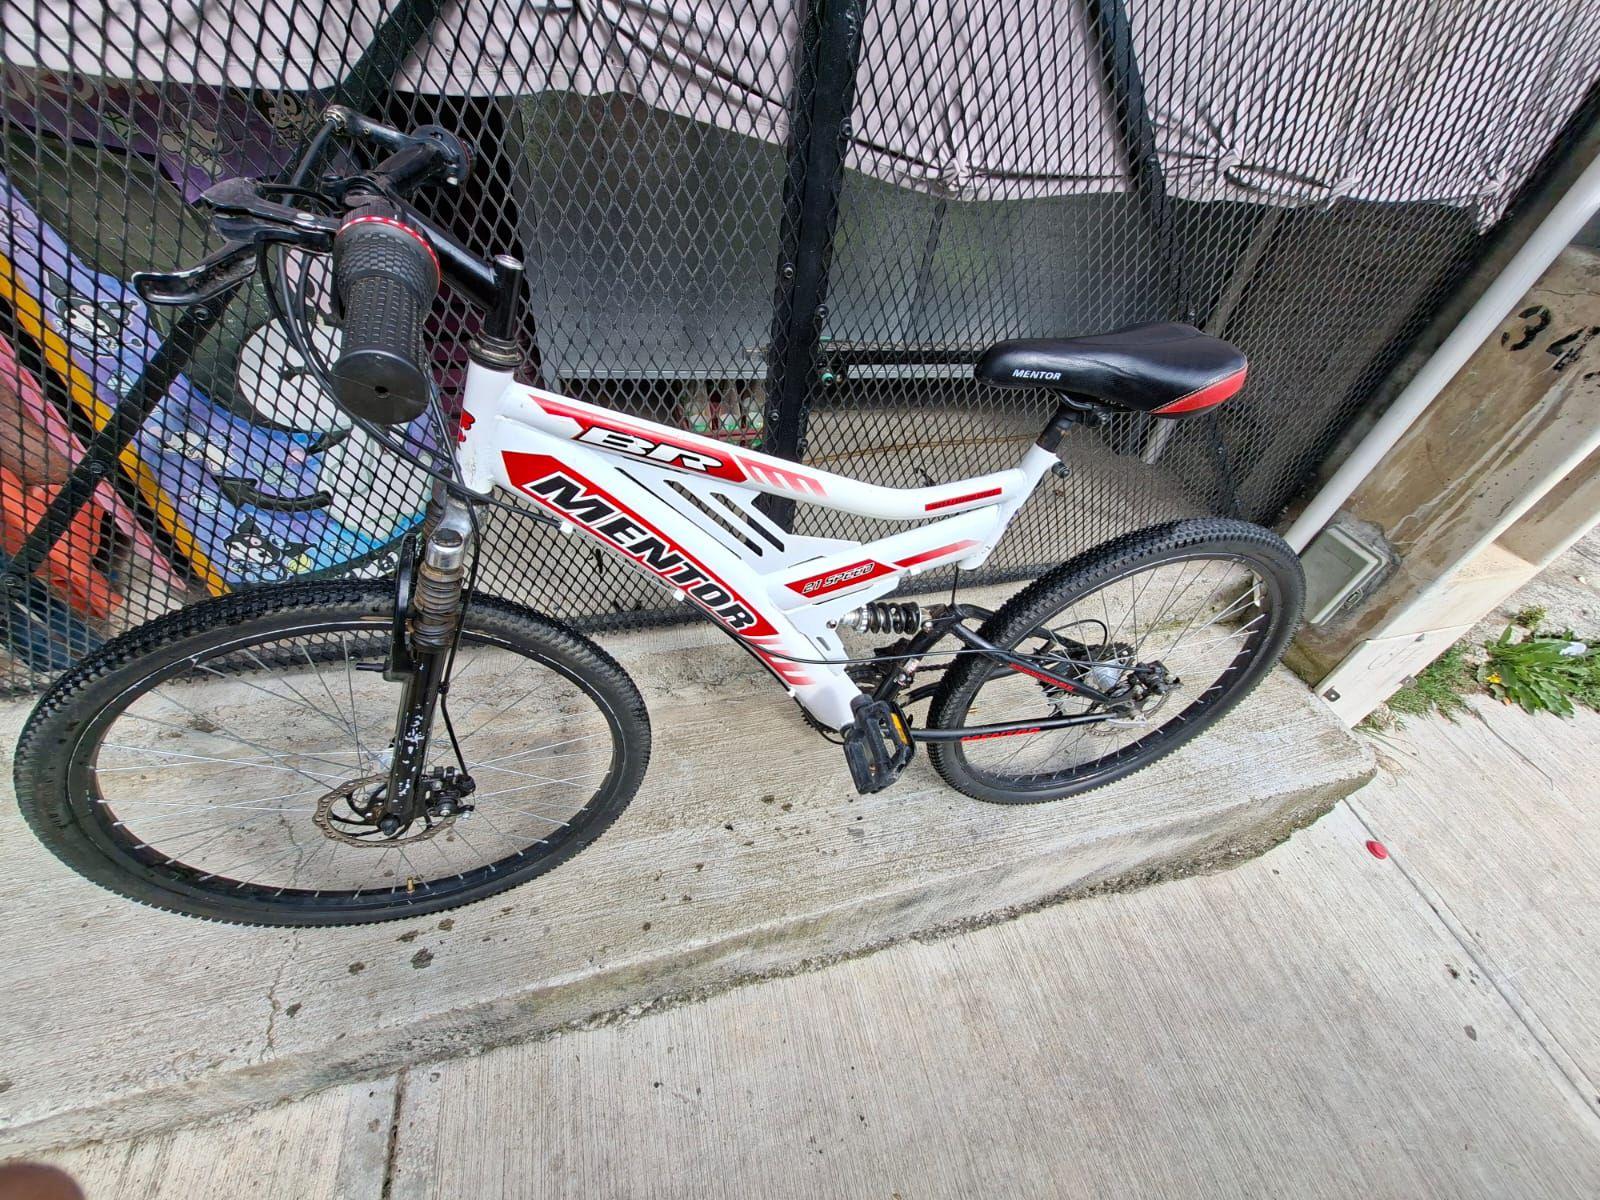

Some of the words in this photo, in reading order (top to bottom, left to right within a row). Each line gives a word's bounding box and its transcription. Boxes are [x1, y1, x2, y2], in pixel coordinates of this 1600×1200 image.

[1012, 368, 1062, 381] MENTOR
[579, 427, 724, 471] BR
[522, 474, 757, 632] MENTOR
[803, 580, 822, 593] 21
[823, 563, 874, 586] SPEED
